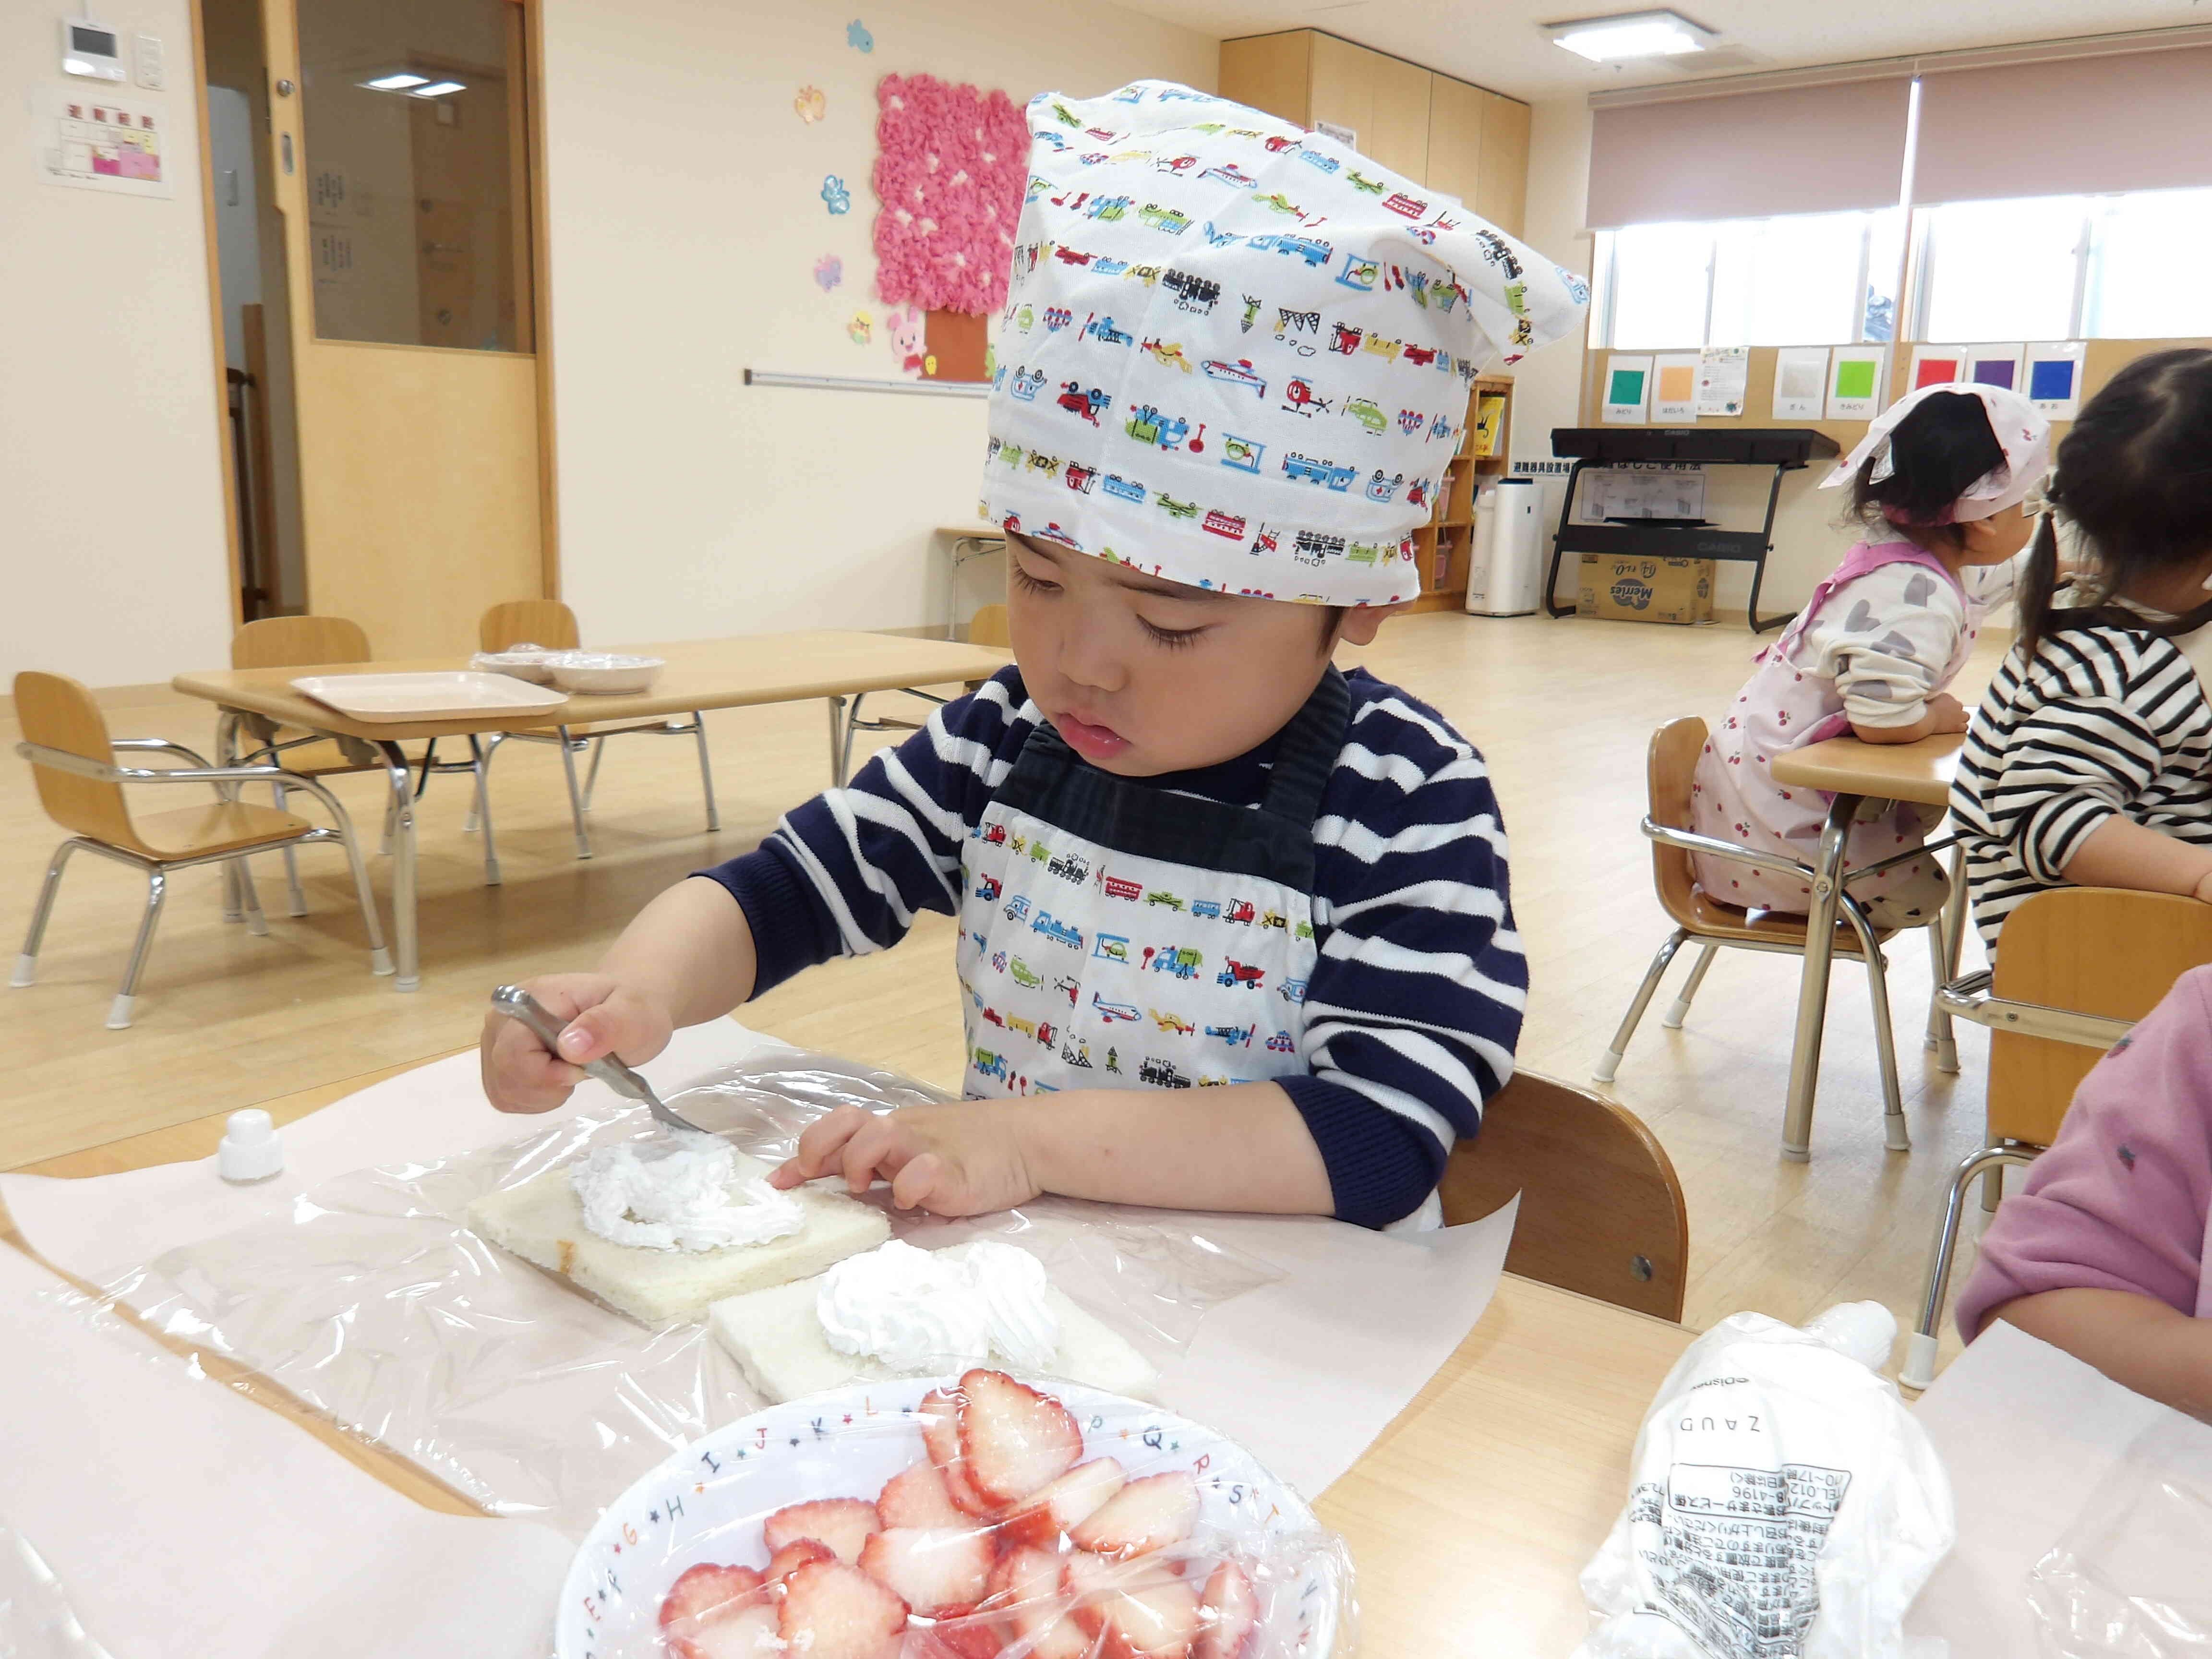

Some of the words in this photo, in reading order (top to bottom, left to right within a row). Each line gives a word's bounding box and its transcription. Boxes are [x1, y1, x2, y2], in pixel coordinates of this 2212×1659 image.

[1697, 541, 1742, 553] CASIO
[1680, 1416, 1761, 1432] ZAUD
[665, 1495, 685, 1521] H
[701, 1451, 721, 1474] I
[755, 1428, 769, 1449] J
[1142, 1425, 1163, 1451] Q
[1193, 1453, 1210, 1475] R
[1229, 1485, 1243, 1504] S
[1264, 1503, 1280, 1524] T
